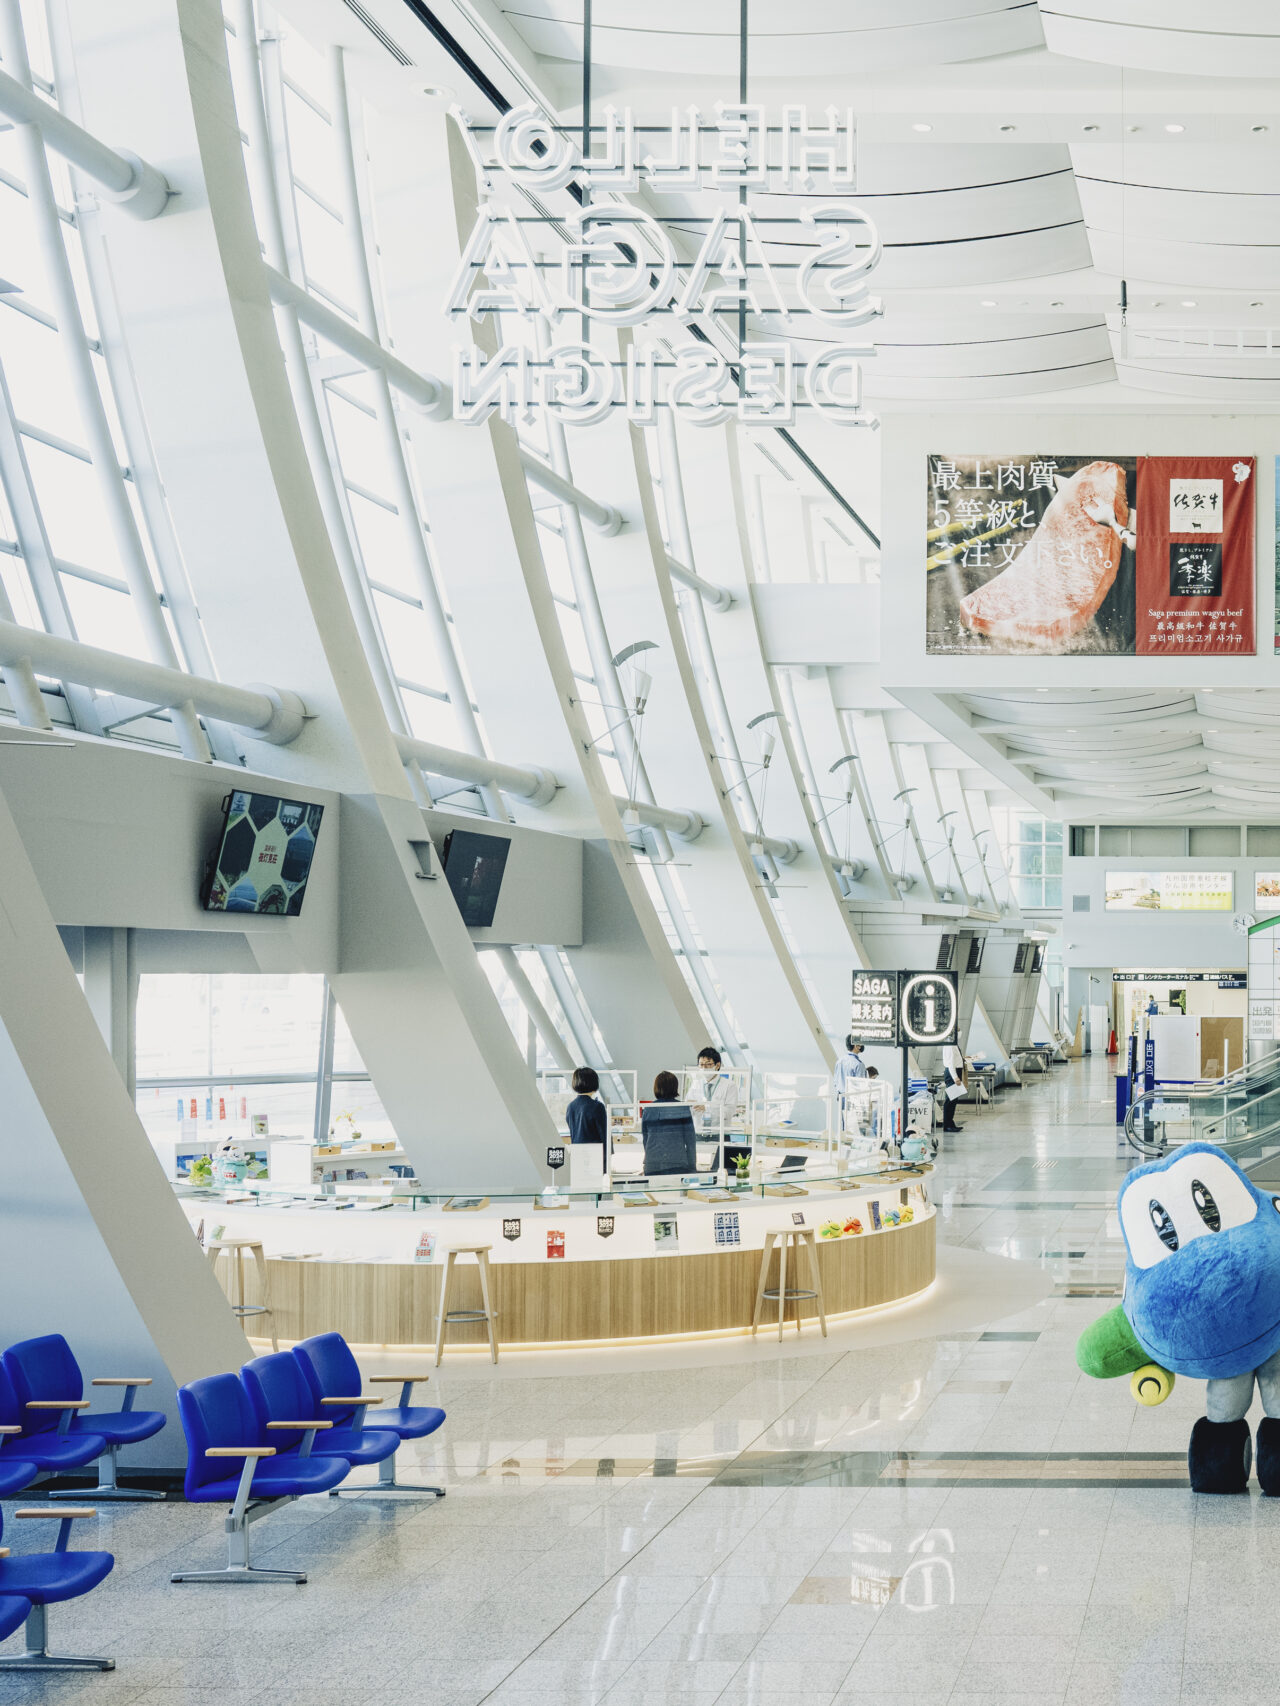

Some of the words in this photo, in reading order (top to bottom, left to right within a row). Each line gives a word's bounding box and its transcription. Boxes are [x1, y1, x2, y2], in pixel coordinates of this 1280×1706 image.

[932, 460, 1059, 491] 最上肉質
[1148, 609, 1165, 619] Saga
[1166, 610, 1200, 619] premium
[1202, 610, 1226, 620] wagyu
[1226, 608, 1244, 617] beef
[1216, 634, 1243, 643] 사가규
[854, 978, 890, 995] SAGA
[1252, 1006, 1273, 1016] 出発
[1146, 1043, 1154, 1058] 出口
[1145, 1060, 1154, 1077] EXIT
